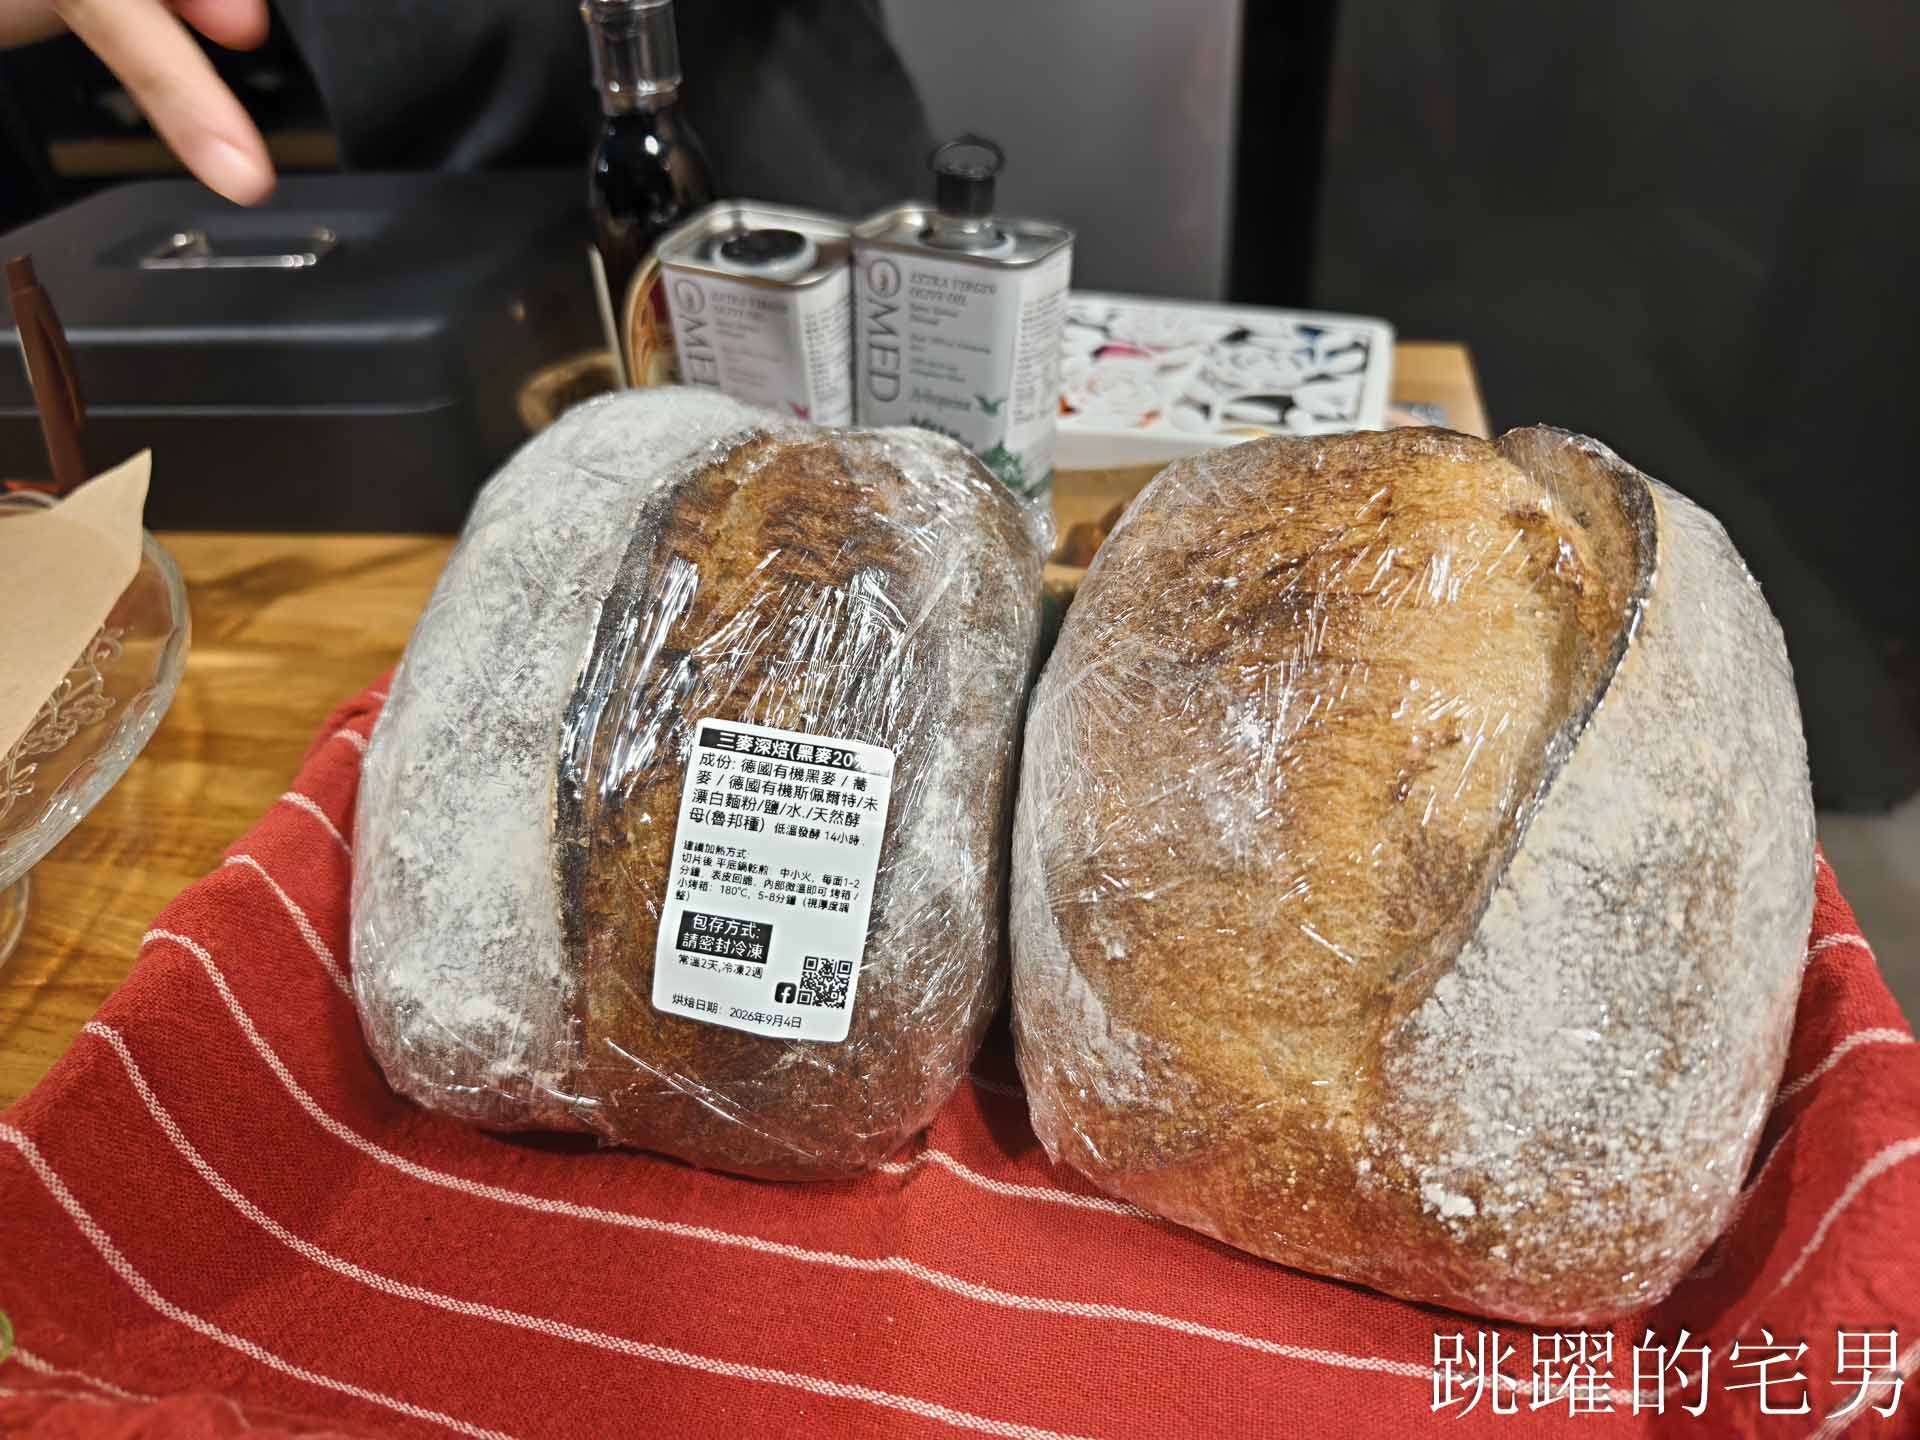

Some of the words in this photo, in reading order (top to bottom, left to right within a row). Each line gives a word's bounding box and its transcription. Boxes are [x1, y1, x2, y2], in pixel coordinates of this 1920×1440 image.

[867, 258, 901, 403] OMED
[681, 932, 764, 960] 請密封冷凍
